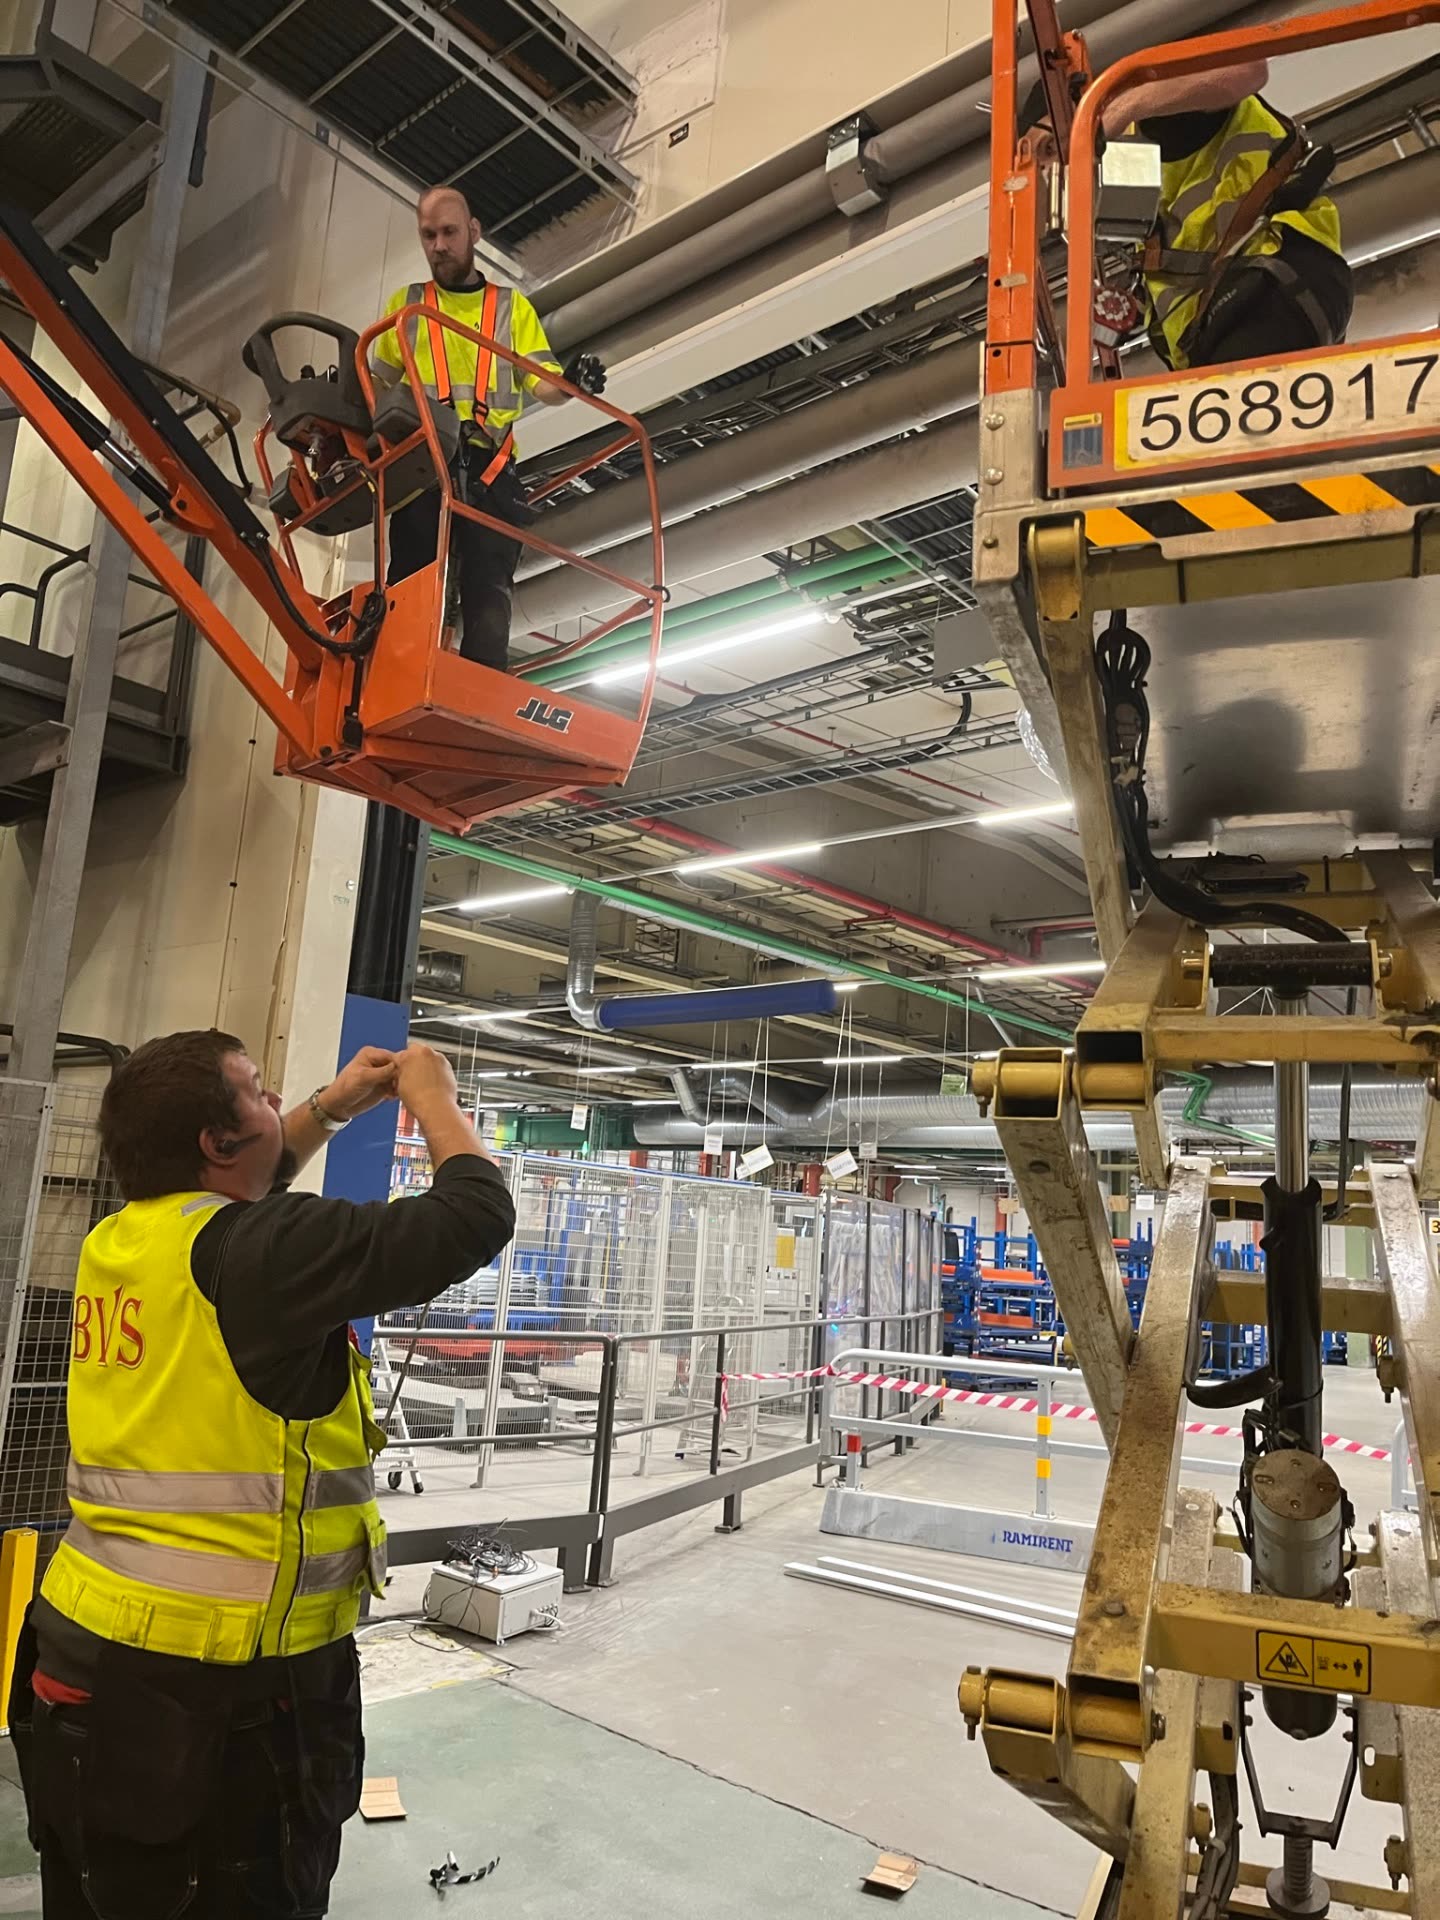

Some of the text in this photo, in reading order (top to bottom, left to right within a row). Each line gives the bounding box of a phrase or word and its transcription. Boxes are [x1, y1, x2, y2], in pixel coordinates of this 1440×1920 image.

[1139, 354, 1439, 451] 568917
[515, 696, 574, 734] JLG
[73, 1283, 146, 1370] BVS
[1002, 1530, 1074, 1553] RAMIRENT
